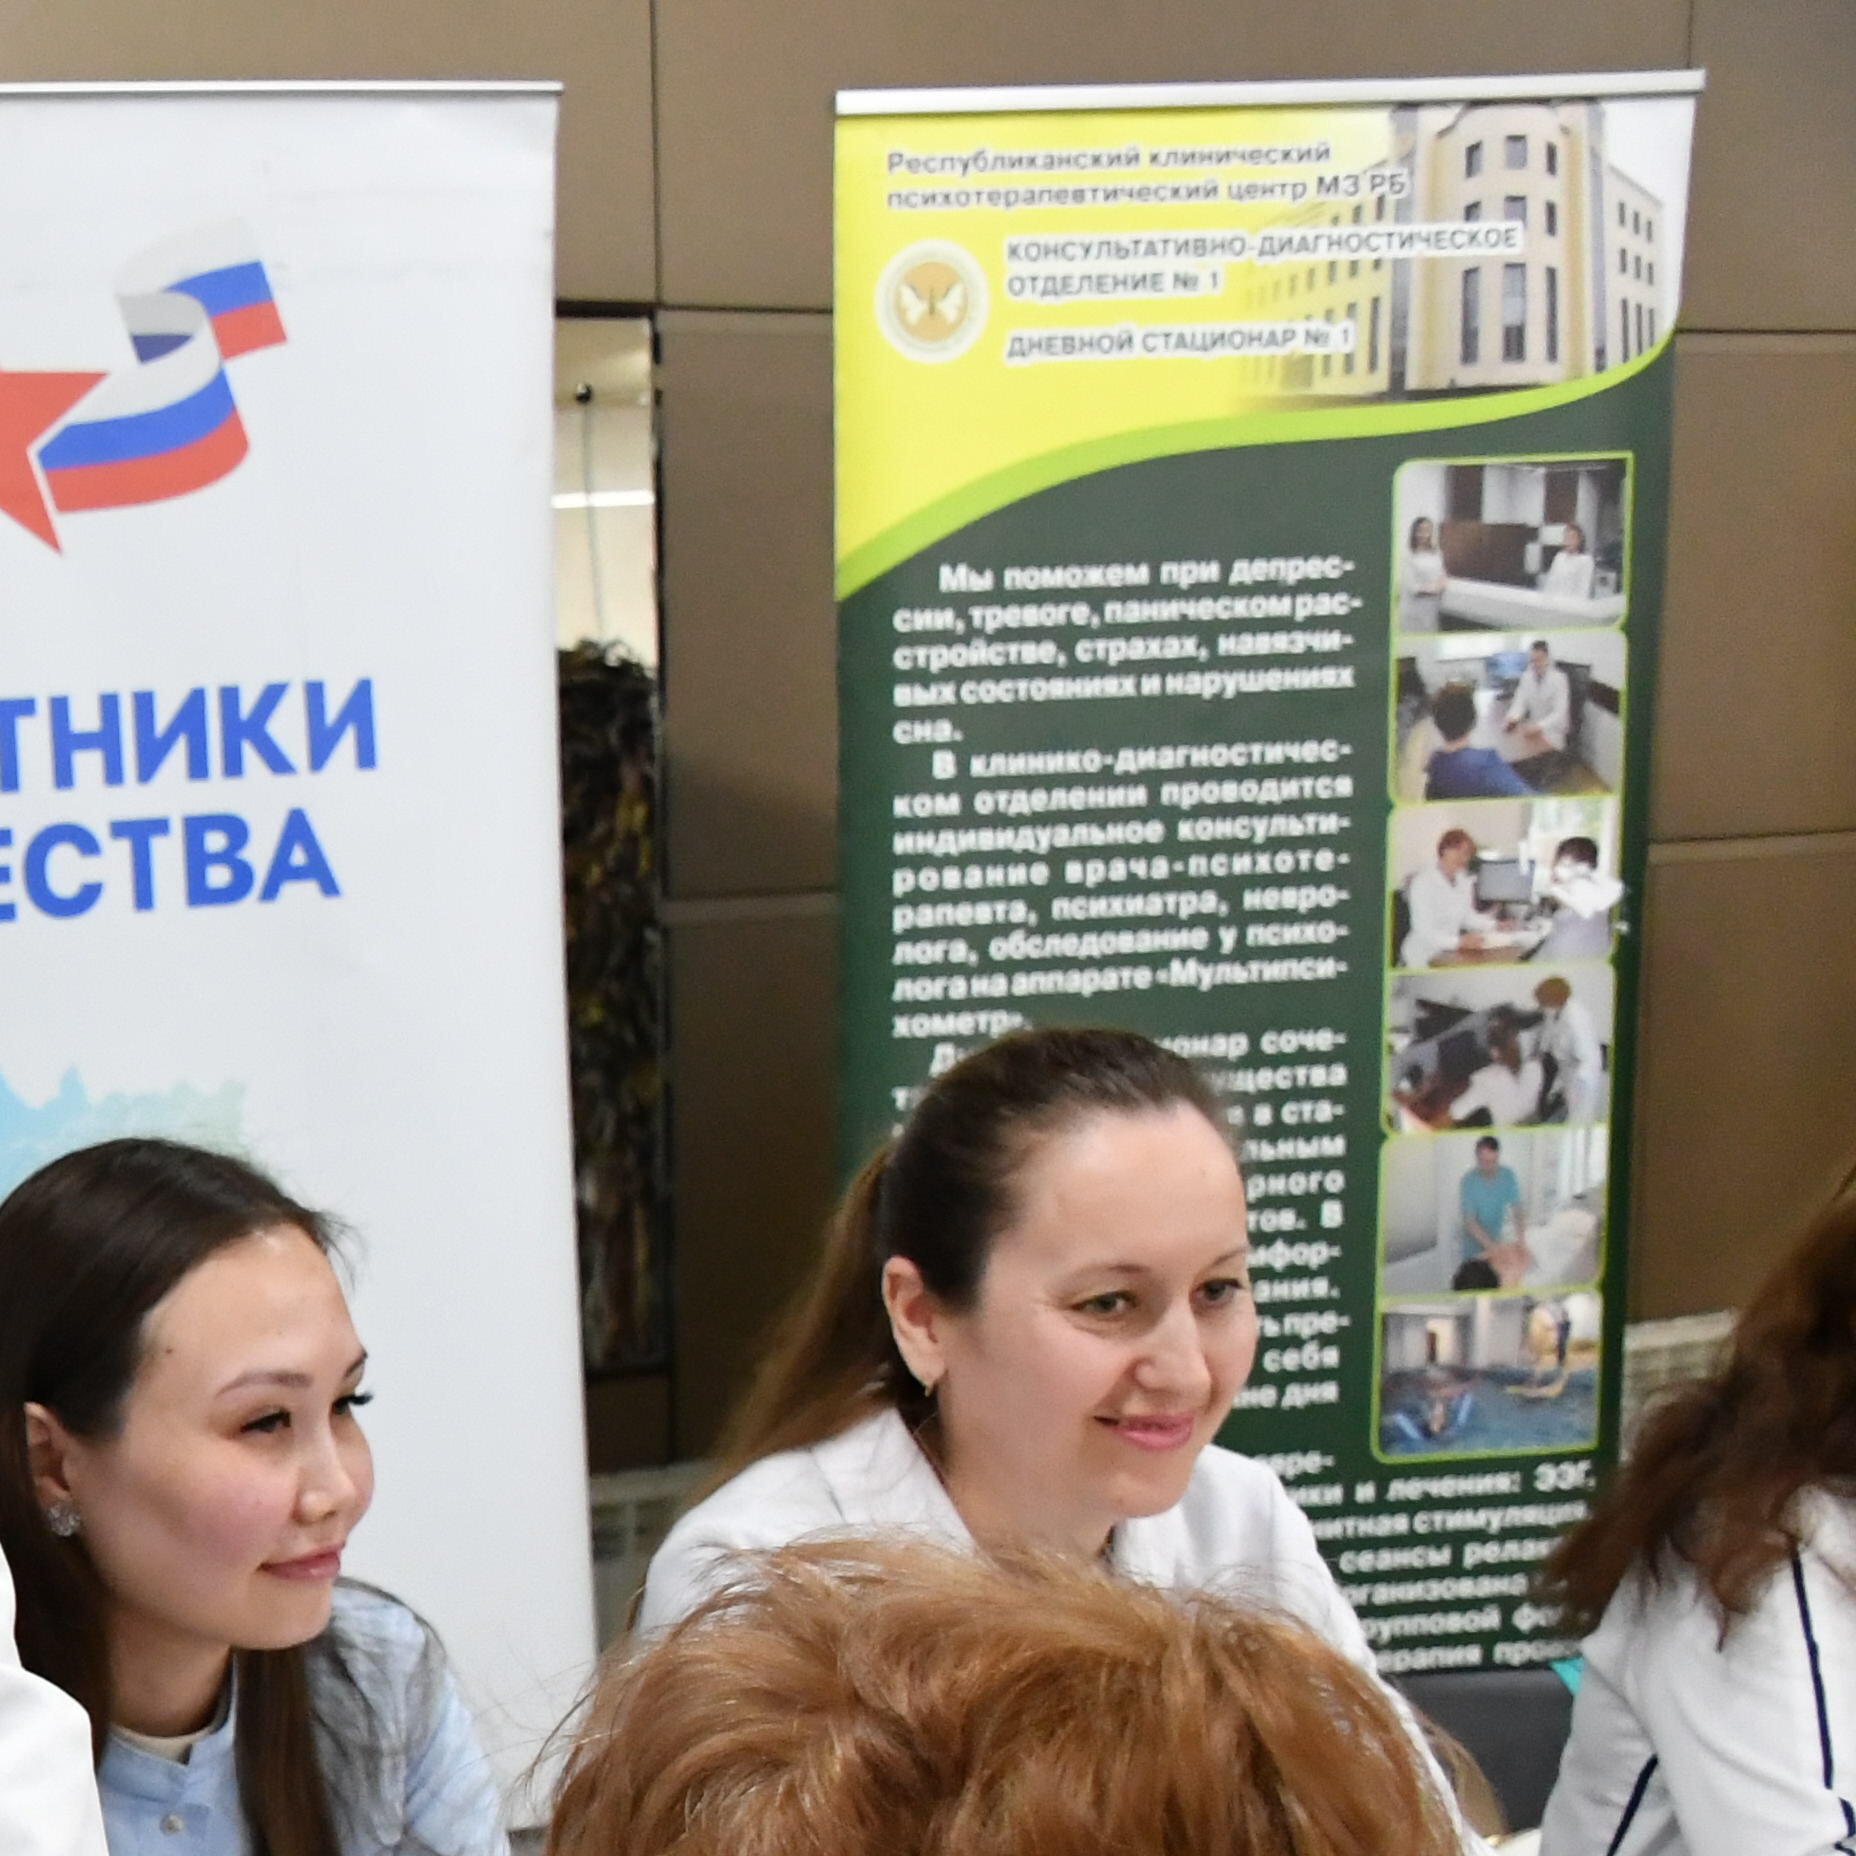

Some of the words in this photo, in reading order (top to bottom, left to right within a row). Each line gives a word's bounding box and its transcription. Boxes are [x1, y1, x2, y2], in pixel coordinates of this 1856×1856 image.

[888, 149, 1141, 177] Республиканский
[1148, 143, 1332, 169] клинический
[887, 180, 1219, 210] психотерапевтический
[1227, 179, 1307, 206] центр
[1316, 175, 1360, 196] МЗ
[1369, 172, 1408, 195] РБ
[1007, 226, 1520, 263] КОНСУЛЬТАТИВНО-ДИАГНОСТИЧЕСКОЕ
[1008, 272, 1165, 298] ОТДЕЛЕНИЕ
[1173, 272, 1200, 292] №
[1210, 271, 1220, 290] 1
[1007, 328, 1134, 360] ДНЕВНОЙ
[1142, 327, 1296, 355] СТАЦИОНАР
[1304, 328, 1331, 347] №
[1341, 326, 1352, 347] 1
[939, 563, 995, 593] Мы
[1003, 562, 1150, 591] поможем
[1159, 557, 1220, 589] при
[1228, 554, 1356, 586] депрес-
[892, 605, 965, 635] сии,
[969, 600, 1102, 635] тревоге,
[1104, 593, 1291, 625] паническом
[1295, 590, 1363, 622] рас-
[892, 638, 1068, 674] стройстве,
[1074, 633, 1210, 666] страхах,
[1217, 628, 1355, 657] навязчи-
[892, 680, 957, 707] вых
[960, 674, 1137, 705] состояниях
[1141, 673, 1161, 696] и
[1165, 665, 1356, 700] нарушениях
[892, 716, 964, 745] сна.
[932, 750, 958, 780] В
[969, 738, 1353, 779] клинико-диагностичес-
[892, 792, 962, 819] ком
[973, 782, 1148, 817] отделении
[1159, 774, 1354, 810] проводится
[892, 818, 1165, 857] индивидуальное
[1176, 811, 1352, 845] консульти-
[892, 861, 1051, 897] рование
[1064, 847, 1352, 889] врача-психоте-
[892, 899, 1039, 933] рапевта,
[1050, 889, 1229, 922] психиатра,
[1242, 883, 1351, 913] невро-
[892, 937, 980, 967] лога,
[987, 923, 1210, 962] обследование
[1217, 925, 1238, 954] у
[1245, 920, 1350, 949] психо-
[892, 974, 968, 1002] лога
[970, 972, 1008, 998] на
[1011, 963, 1154, 998] аппарате
[1156, 956, 1348, 993] «Мультипси-
[1259, 1026, 1347, 1056] соче-
[1280, 1097, 1345, 1126] ста-
[1320, 1198, 1344, 1230] В
[1283, 1311, 1352, 1340] пре-
[1262, 1339, 1341, 1374] себя
[1281, 1380, 1340, 1410] дня
